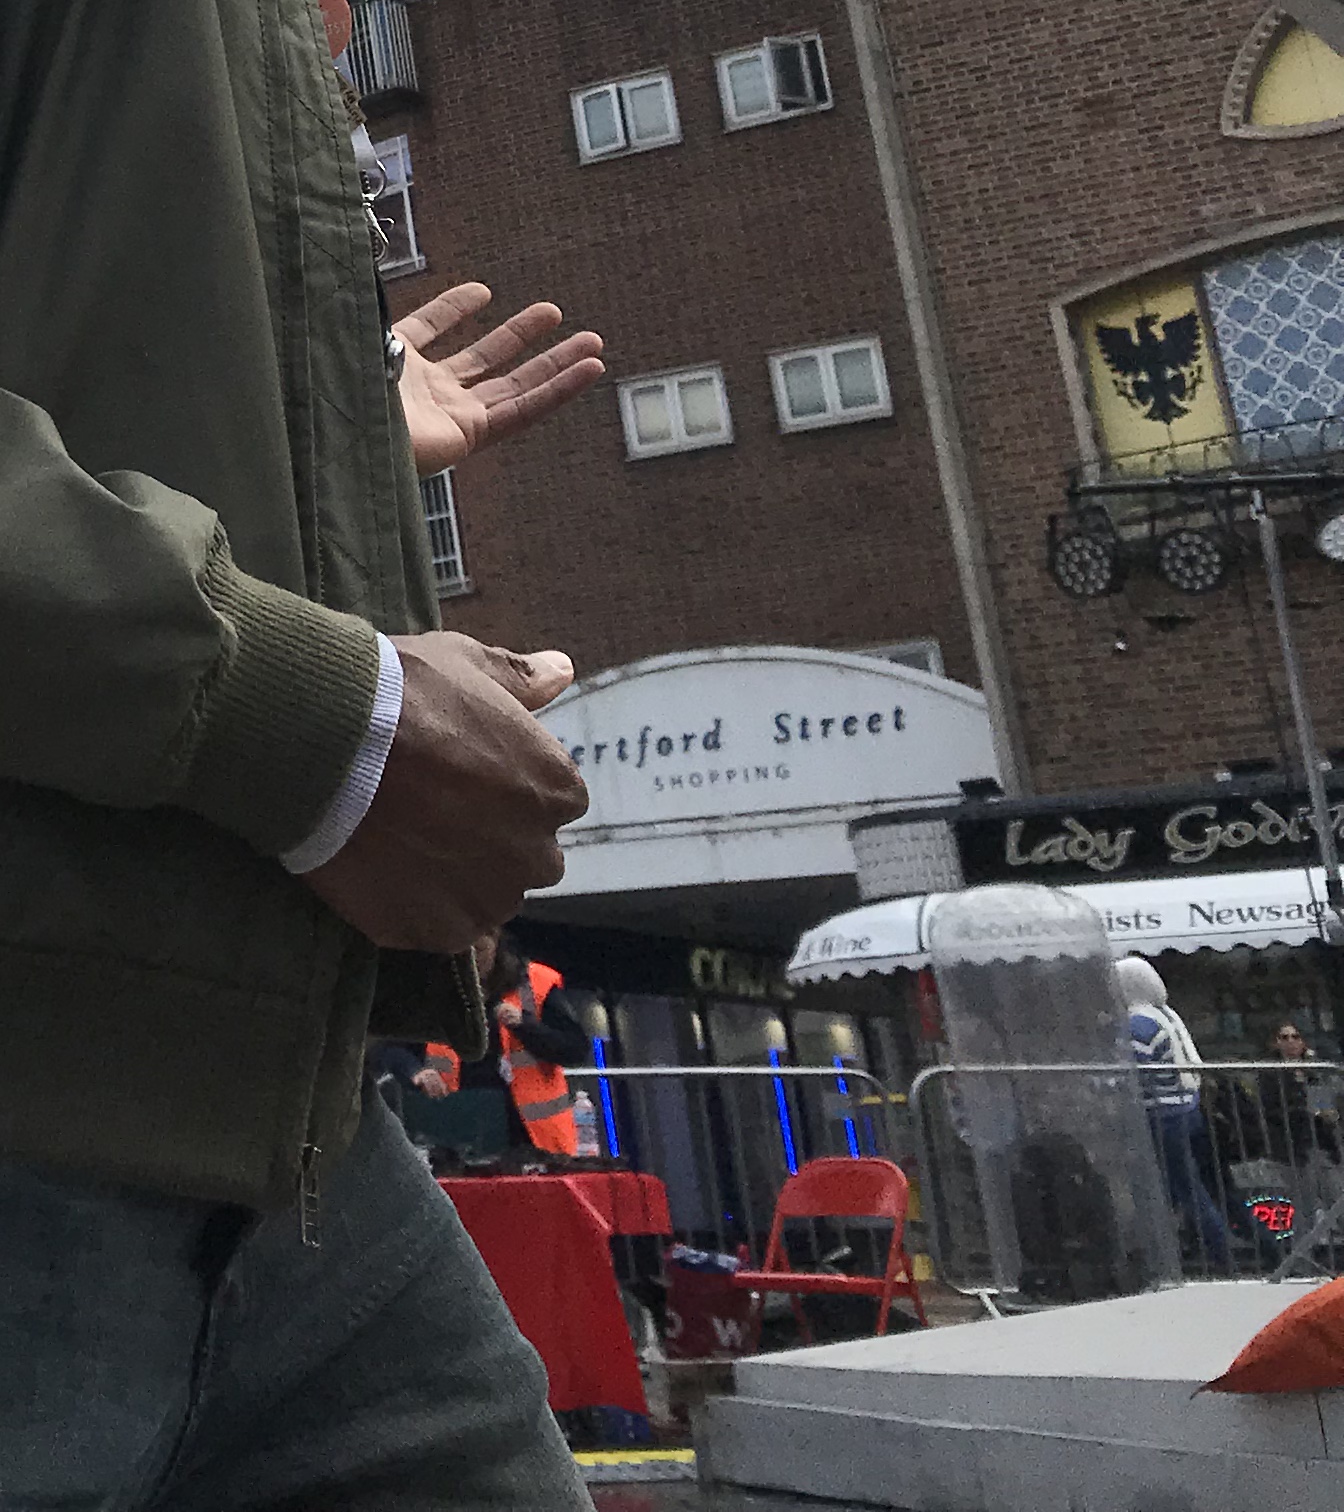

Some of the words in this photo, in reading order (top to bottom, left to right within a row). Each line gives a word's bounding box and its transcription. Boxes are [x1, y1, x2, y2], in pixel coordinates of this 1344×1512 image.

[560, 716, 723, 768] ertford
[773, 705, 907, 745] Street
[653, 762, 792, 791] SHOPPING
[1005, 816, 1137, 872] Lady
[1165, 799, 1344, 864] Godiv
[1188, 900, 1329, 928] Newsag
